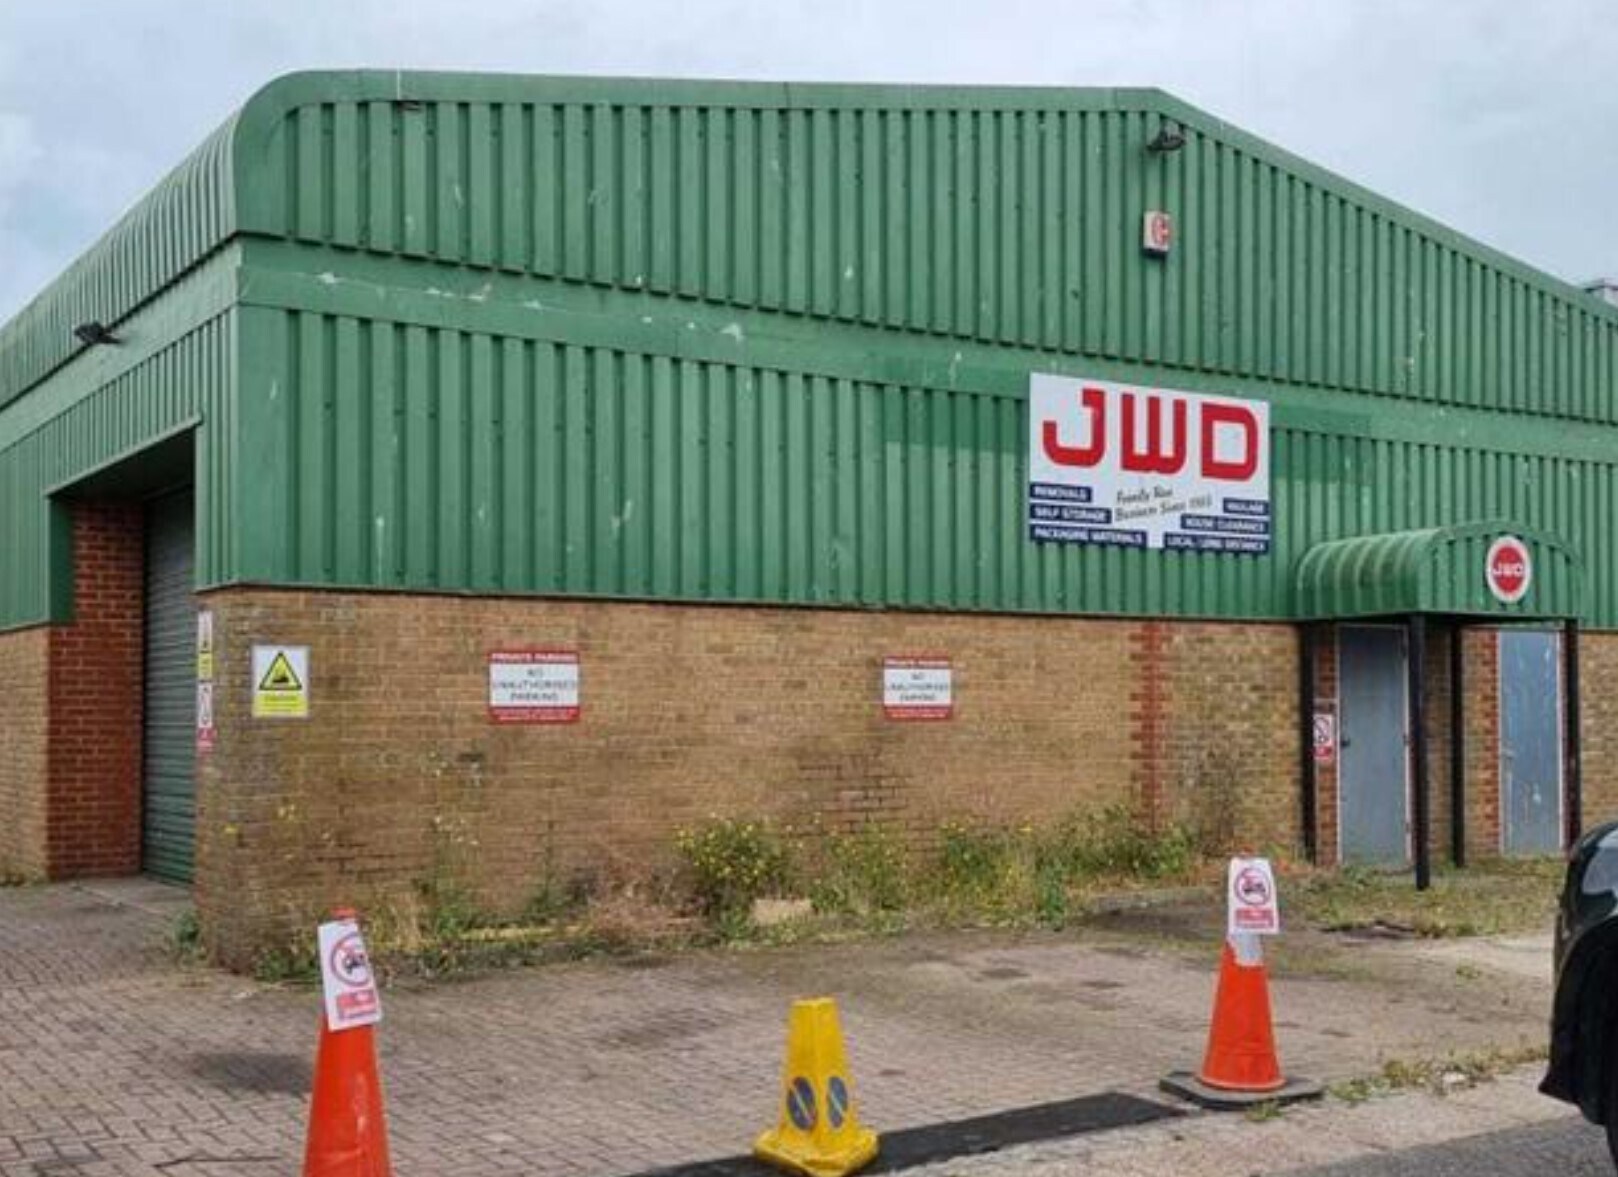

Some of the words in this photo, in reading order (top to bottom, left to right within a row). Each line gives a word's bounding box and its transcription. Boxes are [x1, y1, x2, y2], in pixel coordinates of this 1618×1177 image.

[1043, 388, 1258, 482] JWD
[1034, 486, 1088, 501] REMOVALS
[1034, 506, 1060, 518] SELF
[1062, 508, 1106, 522] STORAGE
[1092, 531, 1143, 544] MATERIALS
[1493, 562, 1524, 578] JWD
